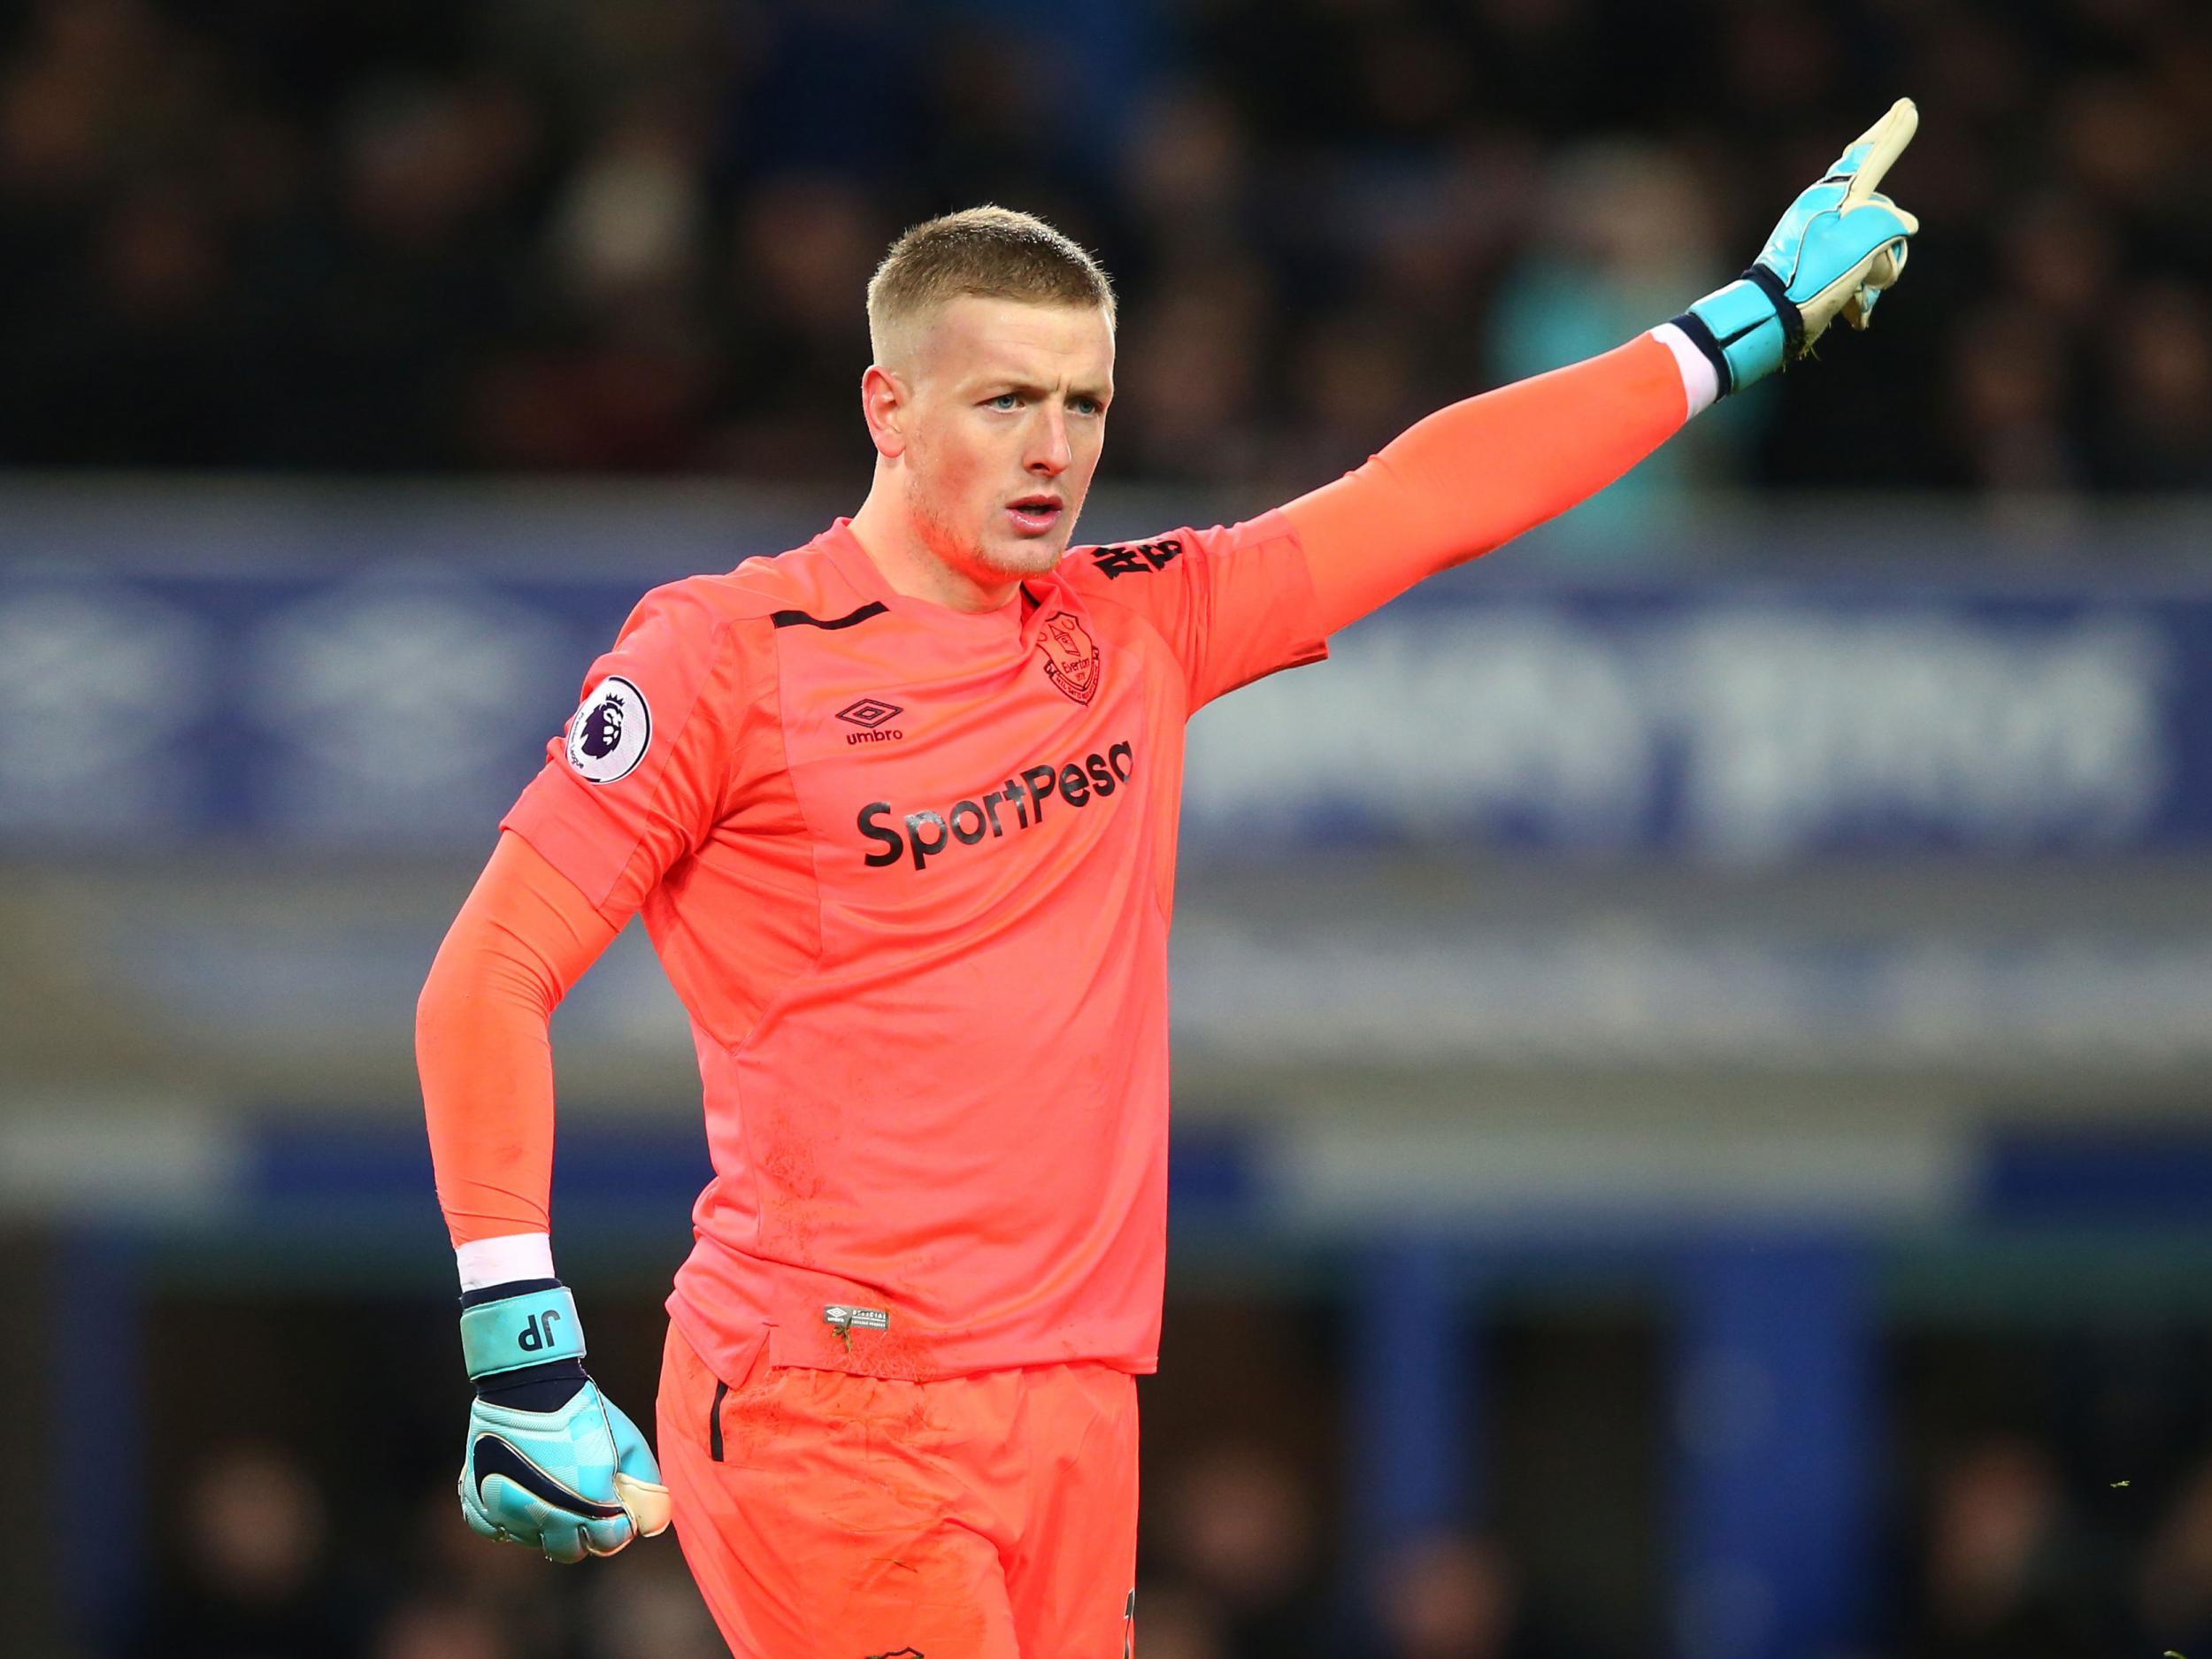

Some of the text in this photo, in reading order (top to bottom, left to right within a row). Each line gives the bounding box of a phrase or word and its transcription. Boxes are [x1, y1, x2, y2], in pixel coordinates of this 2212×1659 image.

[1062, 657, 1090, 674] Everton
[847, 728, 902, 745] umbro
[856, 741, 1133, 871] SportPesa
[518, 1310, 560, 1352] JP
